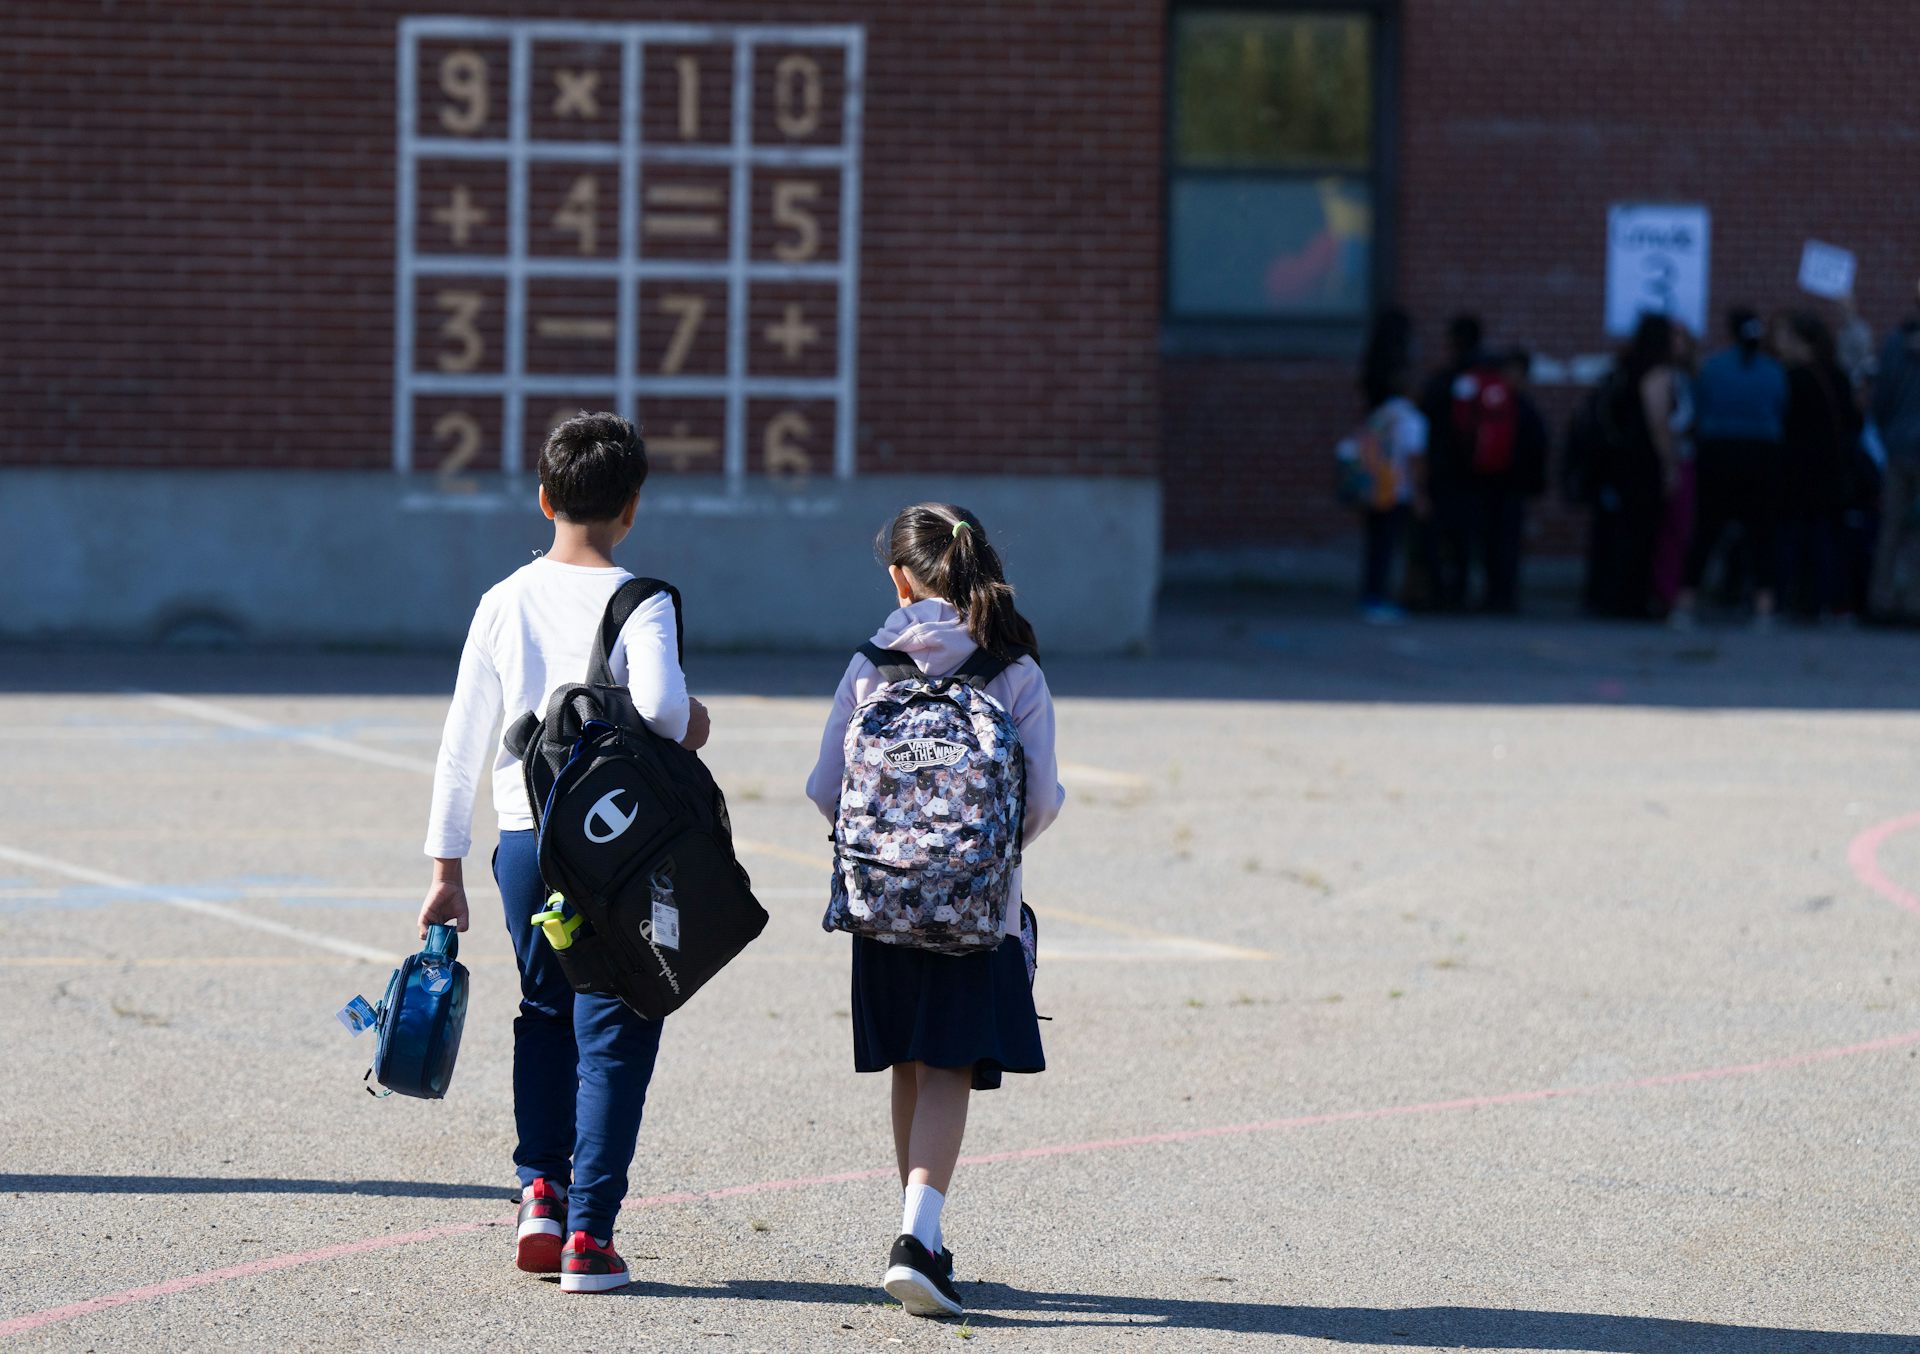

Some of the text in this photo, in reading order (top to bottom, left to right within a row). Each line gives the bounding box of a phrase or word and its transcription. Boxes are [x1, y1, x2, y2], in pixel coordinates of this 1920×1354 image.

[440, 49, 490, 135] 9
[675, 54, 700, 140] 1
[773, 53, 821, 139] 0
[553, 173, 601, 255] 4
[772, 180, 821, 263] 5
[436, 288, 485, 373] 3
[660, 295, 706, 375] 7
[432, 411, 481, 493] 2
[763, 410, 811, 492] 6
[907, 741, 936, 752] VANS
[912, 748, 934, 761] THE
